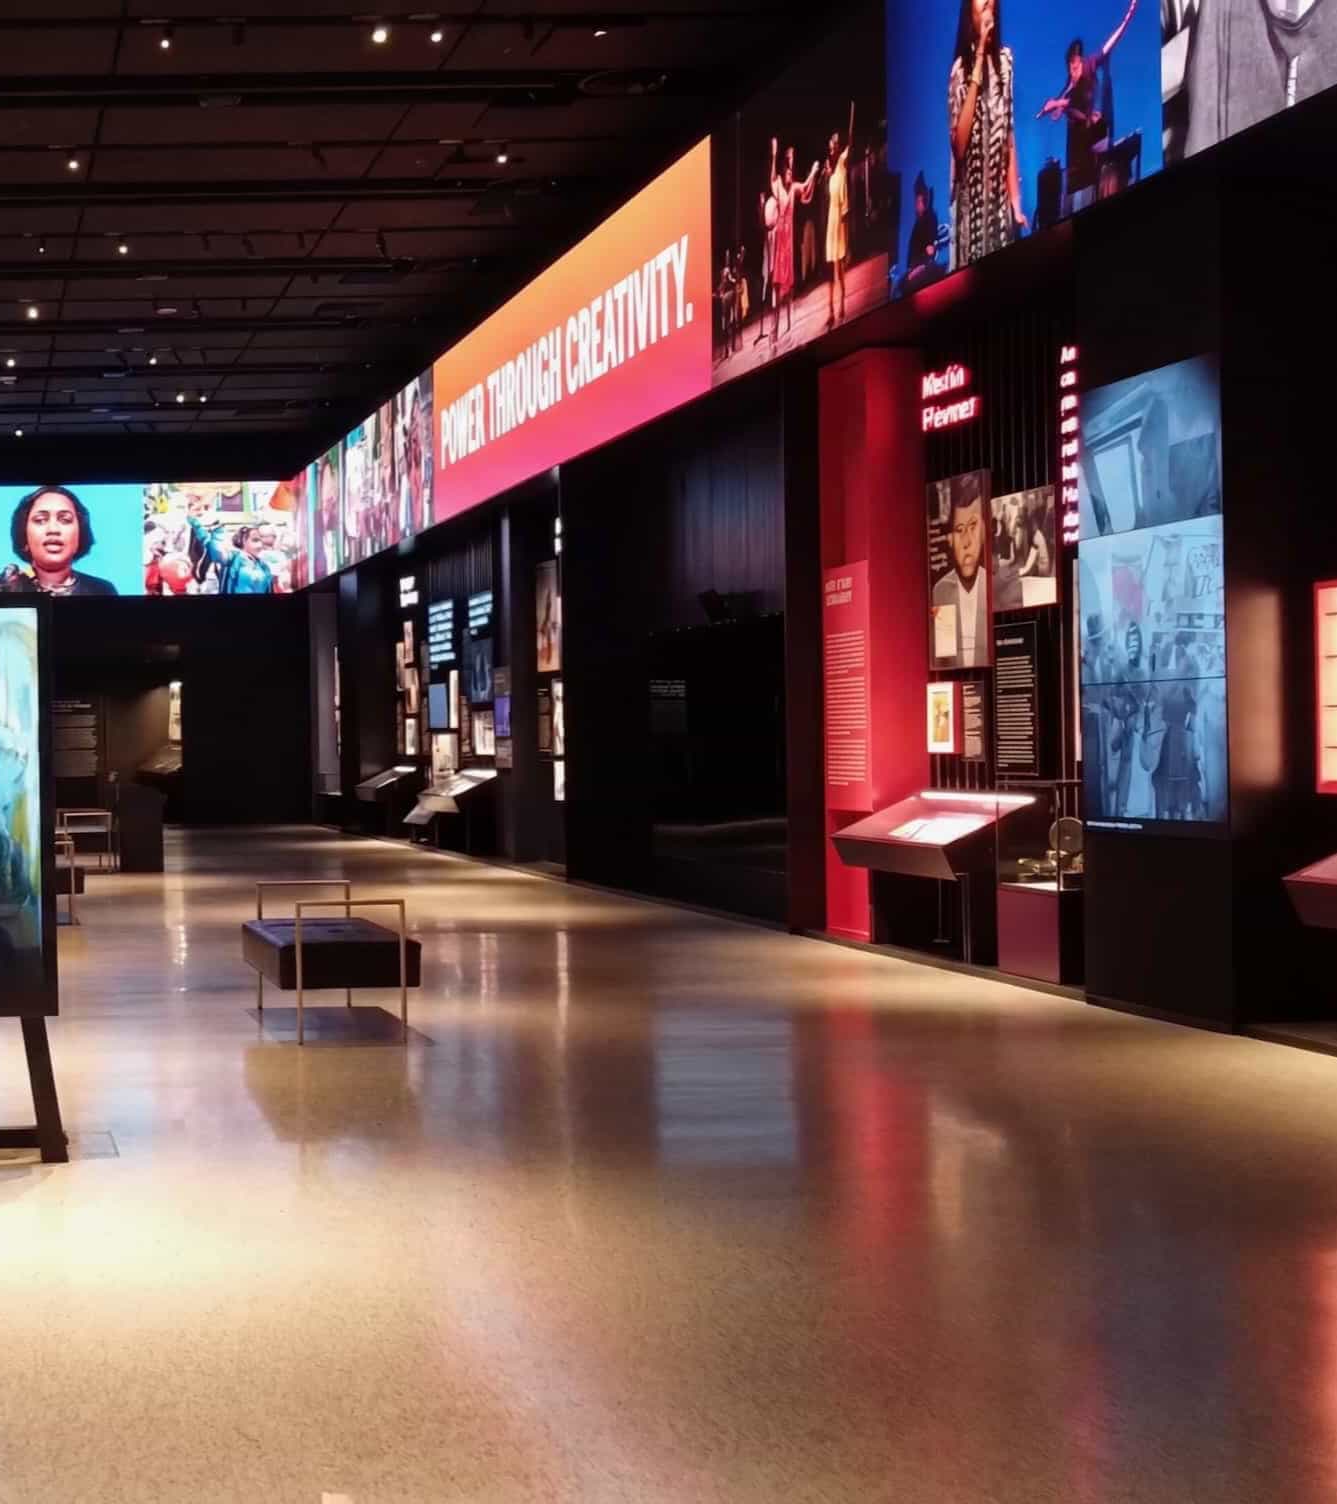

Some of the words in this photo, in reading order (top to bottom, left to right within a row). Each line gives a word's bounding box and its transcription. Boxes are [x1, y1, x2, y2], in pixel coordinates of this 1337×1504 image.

[440, 383, 485, 470] POWER
[486, 326, 562, 441] THROUGH
[565, 234, 693, 395] CREATIVITY.
